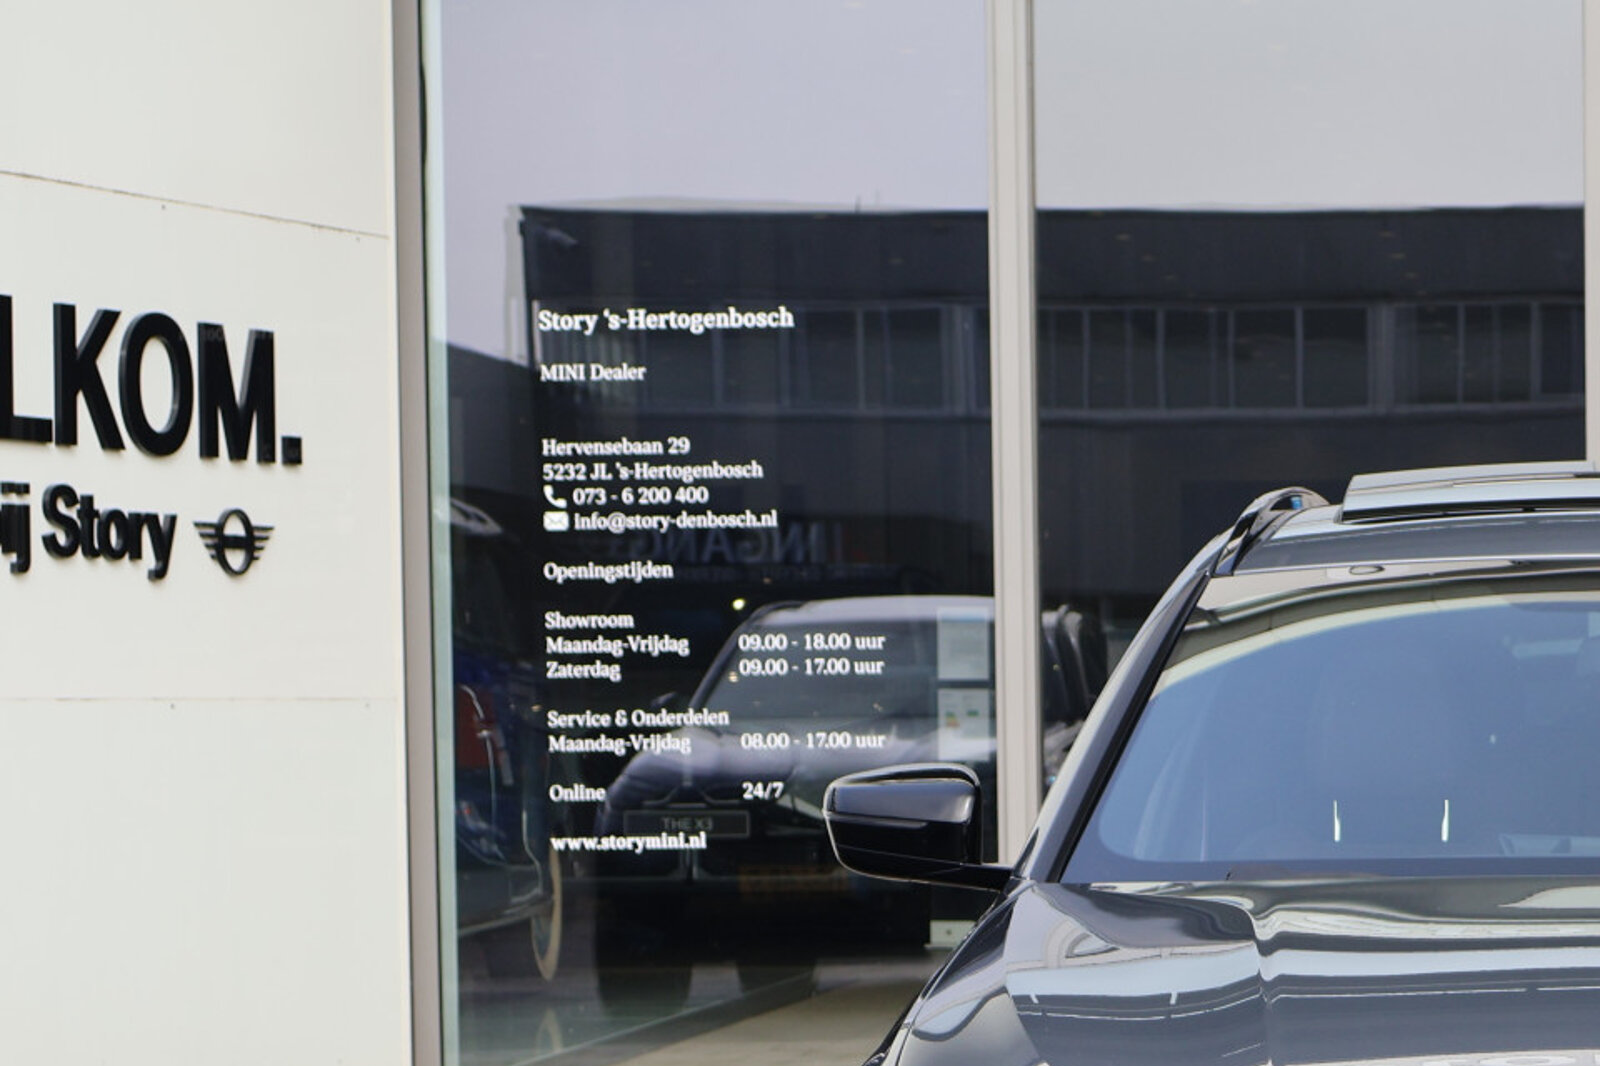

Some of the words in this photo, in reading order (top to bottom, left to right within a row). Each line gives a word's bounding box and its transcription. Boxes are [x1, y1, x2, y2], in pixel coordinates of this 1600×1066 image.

[538, 310, 597, 334] Story
[541, 364, 585, 382] MINI
[590, 363, 646, 382] Dealer
[542, 438, 663, 456] Hervensebaan
[668, 437, 690, 454] 29
[543, 463, 586, 481] 5232
[590, 462, 612, 481] JL
[573, 487, 606, 505] 073
[621, 487, 634, 504] 6
[638, 487, 671, 504] 200
[674, 486, 709, 504] 400
[42, 485, 177, 580] Story
[574, 509, 778, 534] info@story-denbosch.nl
[543, 561, 673, 583] Openingstijden
[545, 611, 634, 629] Showroom
[546, 635, 689, 657] Maandag-Vrijdag
[738, 633, 787, 651] 09.00
[803, 633, 851, 651] 18.00
[854, 635, 886, 650] uur
[546, 660, 621, 682] Zaterdag
[739, 658, 787, 676] 09.00
[804, 658, 851, 676] 17.00
[854, 660, 886, 675] uur
[547, 710, 611, 728] Service
[615, 710, 628, 727] &
[631, 708, 729, 728] Onderdelen
[548, 734, 691, 756] Maandag-Vrijdag
[740, 732, 790, 750] 08.00
[805, 731, 852, 750] 17.00
[855, 734, 886, 749] uur
[549, 784, 606, 802] Online
[742, 782, 784, 800] 24/7
[551, 832, 707, 854] www.storymini.nl
